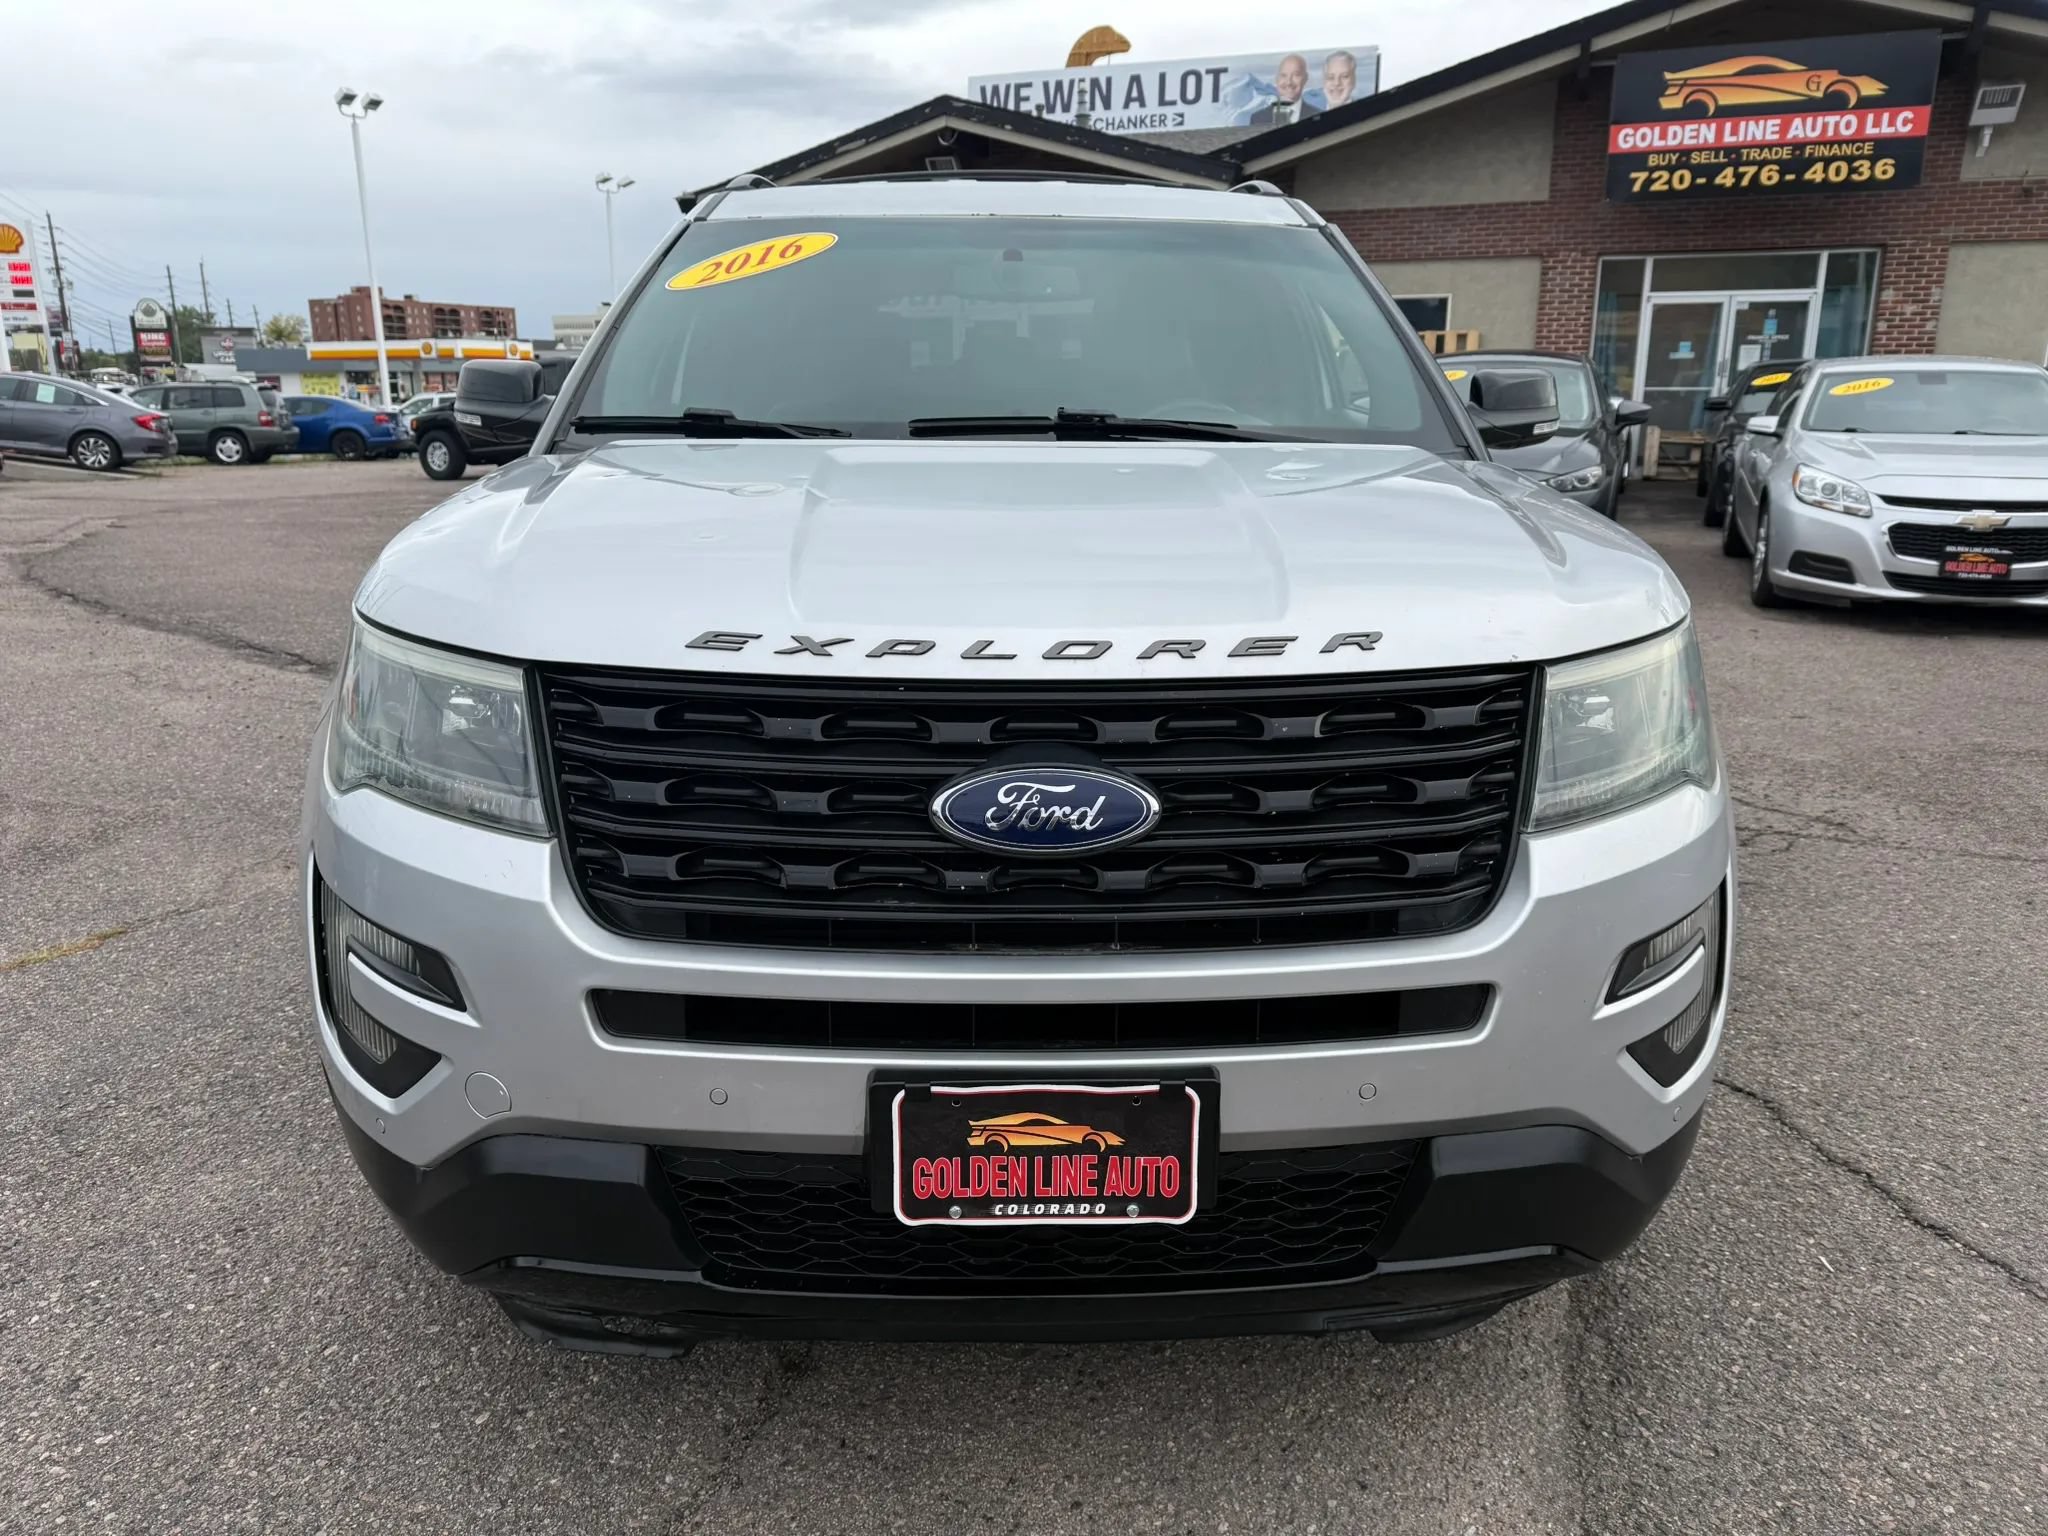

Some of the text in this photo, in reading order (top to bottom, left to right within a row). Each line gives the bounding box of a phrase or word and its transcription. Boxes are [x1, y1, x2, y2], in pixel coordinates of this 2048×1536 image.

[980, 67, 1229, 114] WE WN A LOT
[1806, 74, 1822, 93] G
[1617, 111, 1914, 149] GOLDEN LINE AUTO LLC
[1648, 142, 1875, 166] BUY SELL TRADE FINANCE
[1629, 158, 1897, 193] 720-476-4036
[694, 236, 807, 285] 2016
[1844, 380, 1881, 393] 2016
[684, 630, 1385, 661] EXPLORER
[984, 781, 1107, 832] Ford
[912, 1154, 1181, 1200] GOLDEN LINE AUTO
[993, 1203, 1108, 1216] COLORADO
